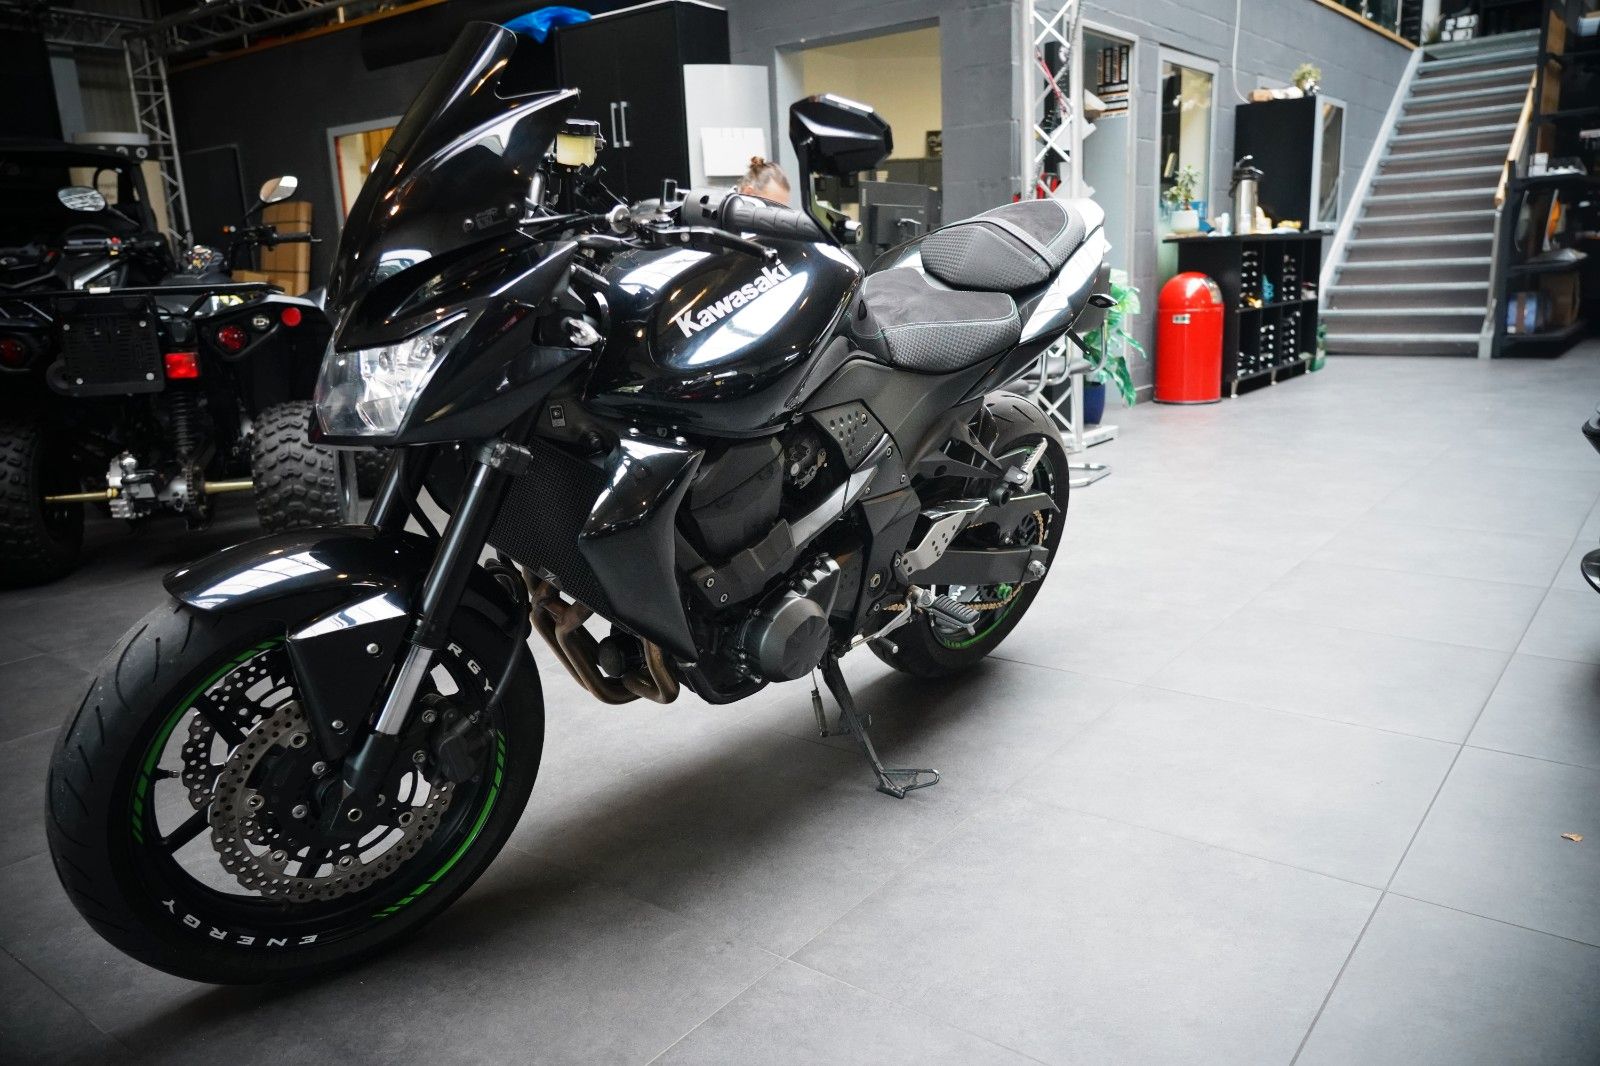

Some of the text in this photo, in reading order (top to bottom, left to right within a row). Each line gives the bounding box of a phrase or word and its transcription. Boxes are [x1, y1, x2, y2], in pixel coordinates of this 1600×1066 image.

[675, 259, 792, 338] Kawasaki
[447, 642, 494, 692] RGY
[162, 899, 319, 947] ENERGY
